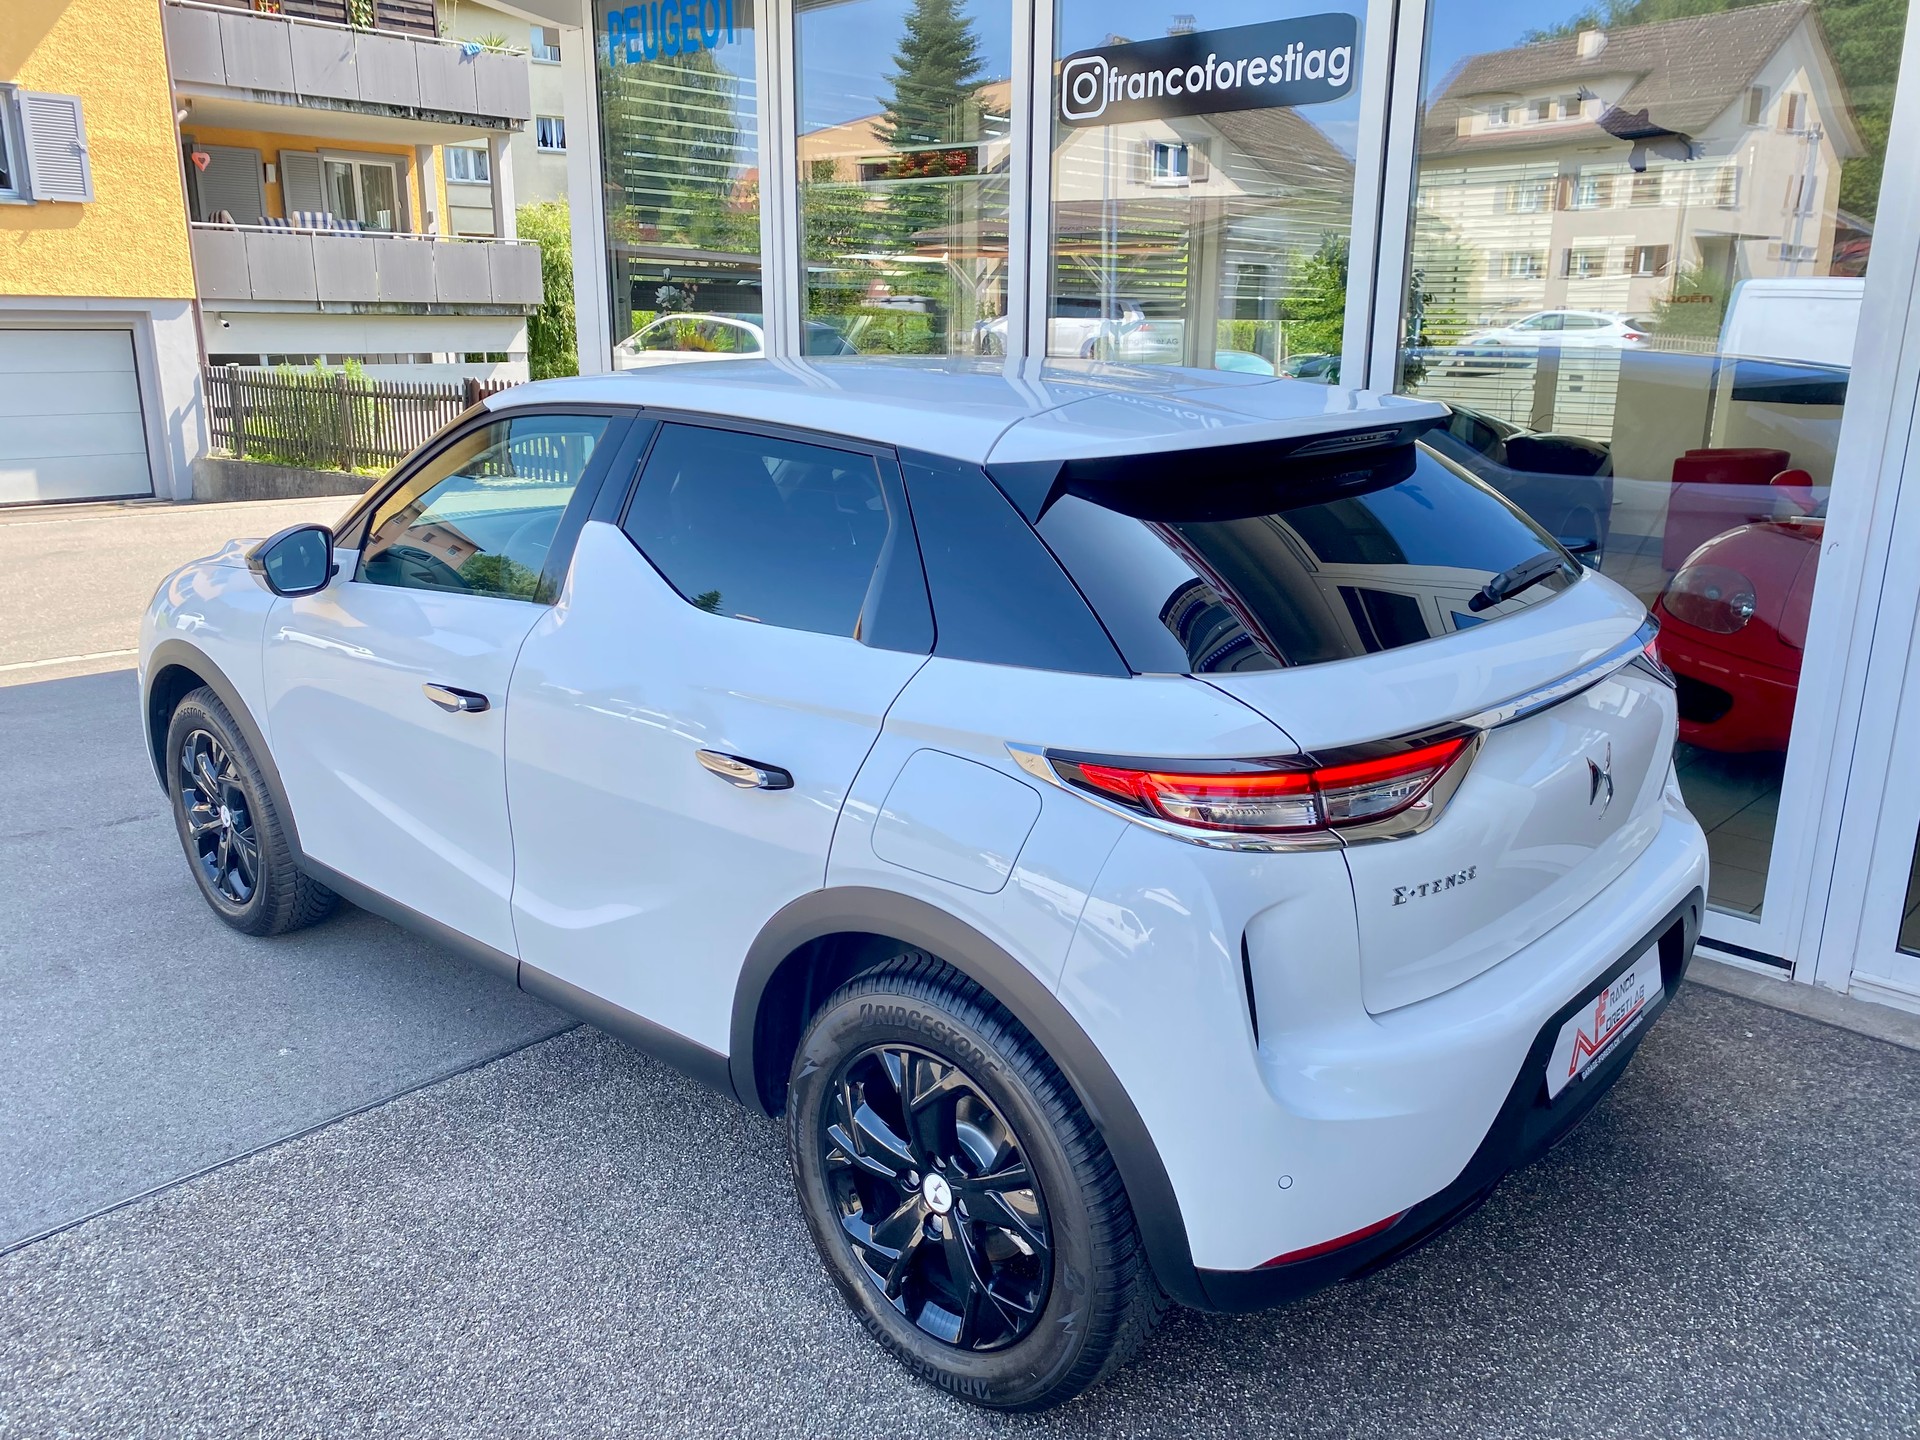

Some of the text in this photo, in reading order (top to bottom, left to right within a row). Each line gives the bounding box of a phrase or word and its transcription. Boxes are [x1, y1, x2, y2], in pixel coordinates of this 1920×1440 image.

[1108, 41, 1351, 103] francoforestiag
[859, 1002, 999, 1082] BRIDGESTONE
[857, 1306, 992, 1400] BRIDGESTONE
